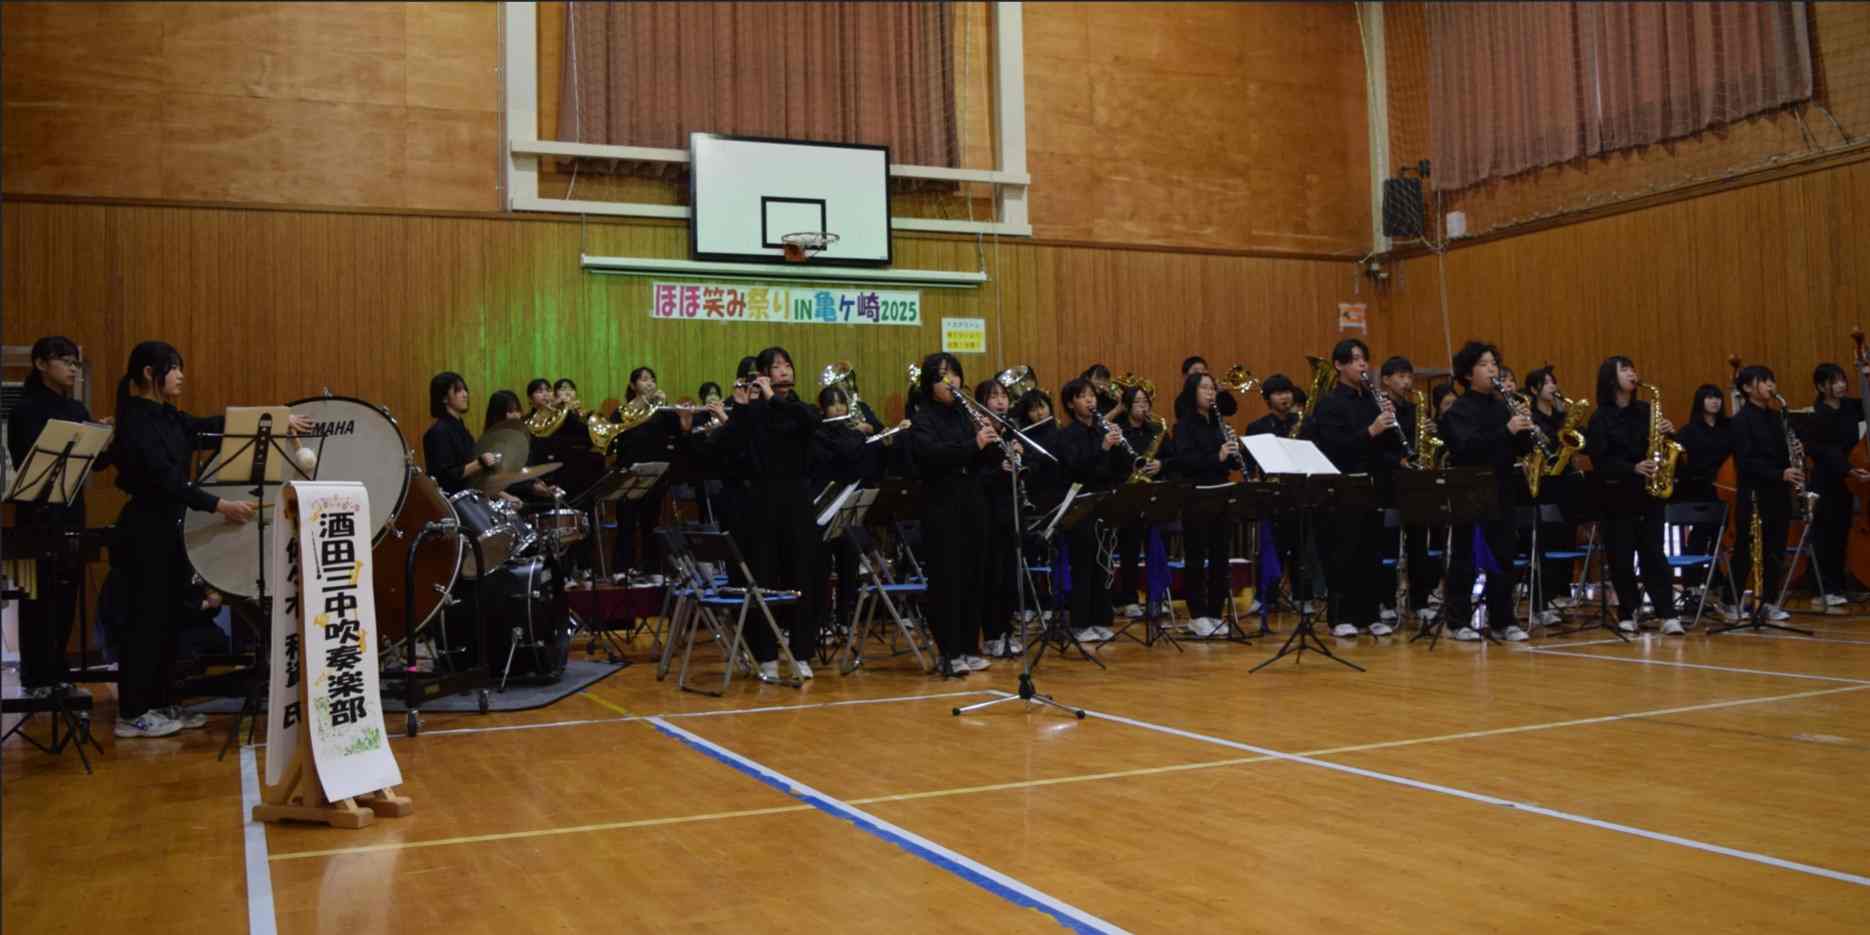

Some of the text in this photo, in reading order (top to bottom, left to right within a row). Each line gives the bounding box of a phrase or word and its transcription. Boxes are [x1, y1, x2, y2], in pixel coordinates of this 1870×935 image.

[312, 420, 355, 435] MAHA
[319, 511, 367, 727] 酒田三中吹奏楽部
